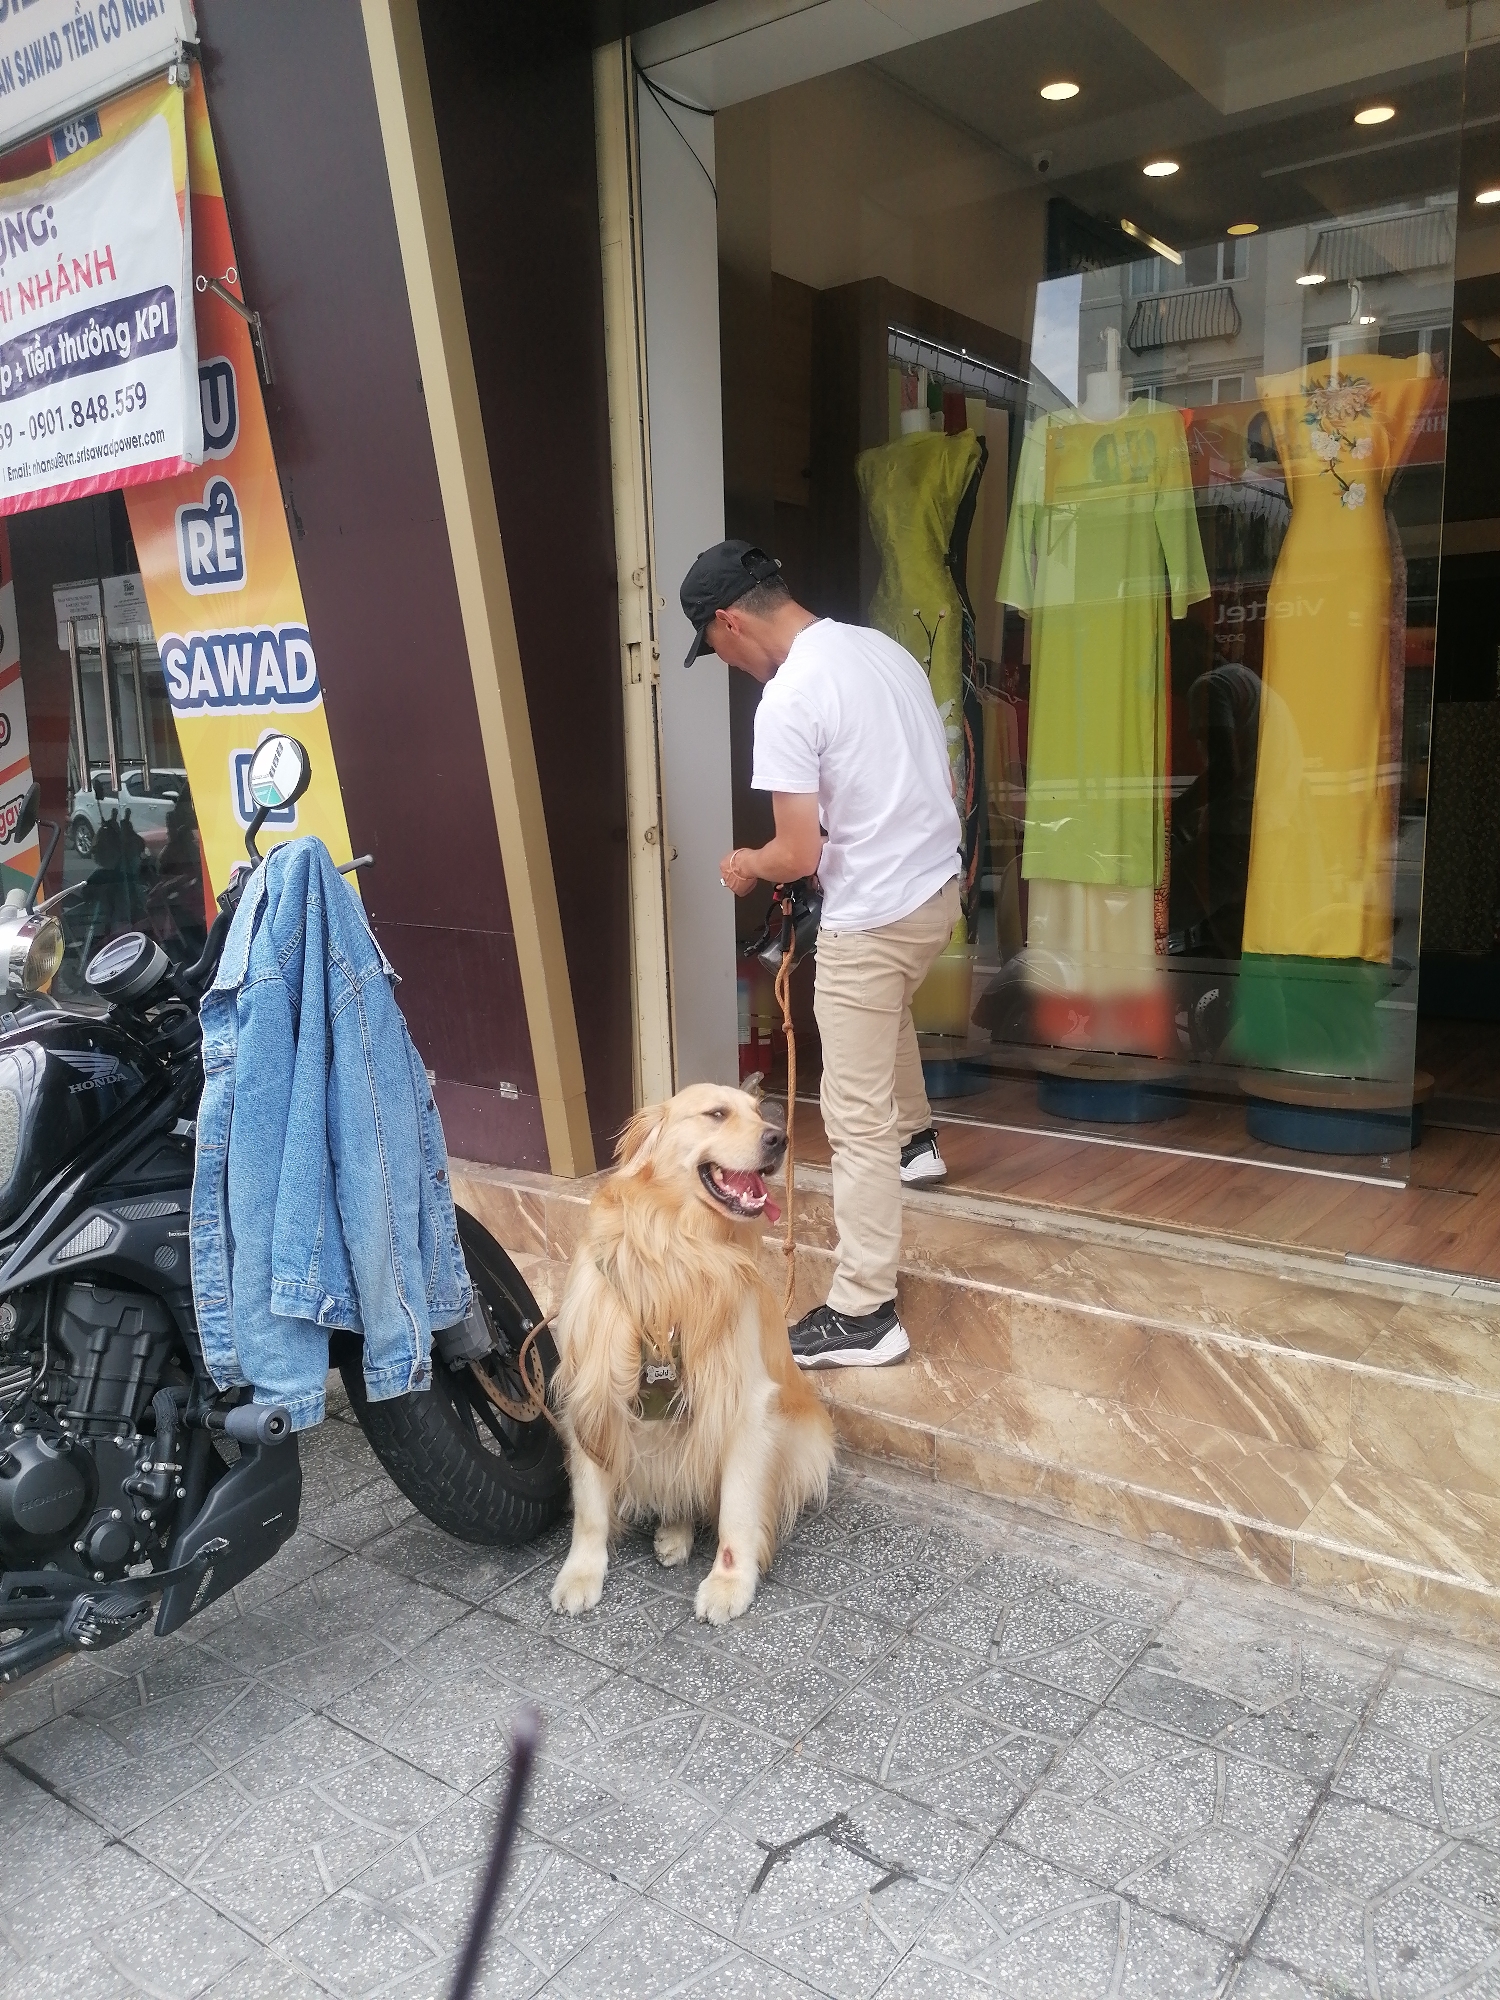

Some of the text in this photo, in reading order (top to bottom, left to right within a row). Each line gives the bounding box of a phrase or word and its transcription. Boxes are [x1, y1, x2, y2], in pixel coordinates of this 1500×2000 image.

[14, 31, 63, 88] SAWAD
[62, 0, 99, 61] TIỀN
[63, 119, 88, 153] 86
[17, 244, 117, 315] NHÁNH
[22, 333, 56, 378] Tiền
[58, 317, 131, 358] thưởng
[135, 302, 169, 342] KPI
[29, 381, 147, 440] 0901.848.559
[7, 464, 31, 482] Email:
[187, 492, 237, 576] RẺ
[166, 638, 316, 699] SAWAD
[68, 1072, 128, 1094] HONDA
